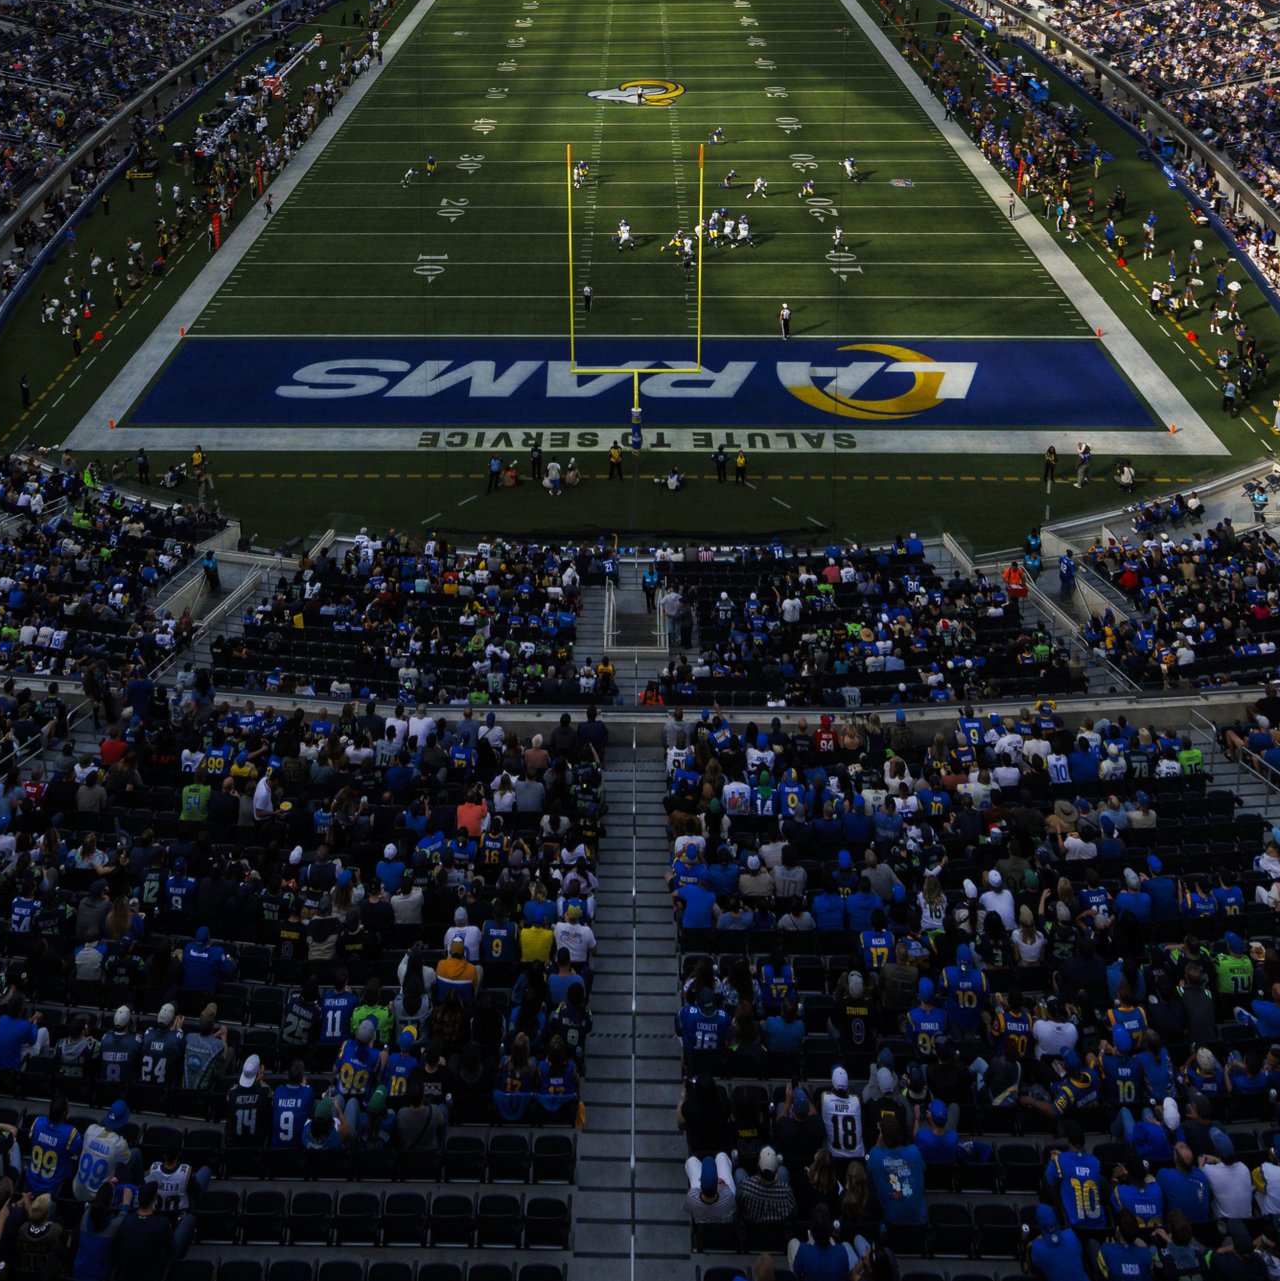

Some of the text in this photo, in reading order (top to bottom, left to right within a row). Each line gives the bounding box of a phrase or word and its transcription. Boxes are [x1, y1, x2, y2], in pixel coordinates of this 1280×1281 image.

[485, 87, 509, 99] 50
[765, 86, 789, 98] 50
[472, 118, 498, 132] 40
[777, 117, 802, 130] 40
[456, 154, 485, 170] 30
[789, 154, 818, 169] 30
[437, 198, 470, 217] 20
[805, 198, 839, 216] 20
[413, 253, 449, 275] 10
[825, 252, 863, 275] 10
[275, 358, 757, 399] RAMS
[419, 430, 857, 450] SALUTE TO SERVICE
[492, 939, 502, 954] 9
[870, 947, 888, 966] 17
[1231, 974, 1252, 994] 14
[956, 990, 976, 1009] 10
[283, 1020, 310, 1044] 25
[326, 1011, 341, 1038] 11
[697, 1022, 718, 1031] LOCKETT
[852, 1018, 866, 1045] 9
[694, 1031, 717, 1050] 16
[141, 1057, 167, 1084] 24
[340, 1064, 368, 1094] 99
[391, 1075, 407, 1096] 10
[1117, 1083, 1136, 1103] 10
[835, 1104, 849, 1114] KUPP
[236, 1109, 256, 1136] 14
[280, 1111, 295, 1141] 9
[38, 1132, 59, 1146] DONALD
[831, 1115, 860, 1152] 18
[32, 1145, 58, 1179] 99
[78, 1153, 109, 1189] 99
[1075, 1166, 1091, 1177] KUPP
[1070, 1179, 1100, 1220] 10
[1134, 1204, 1157, 1215] DONALD
